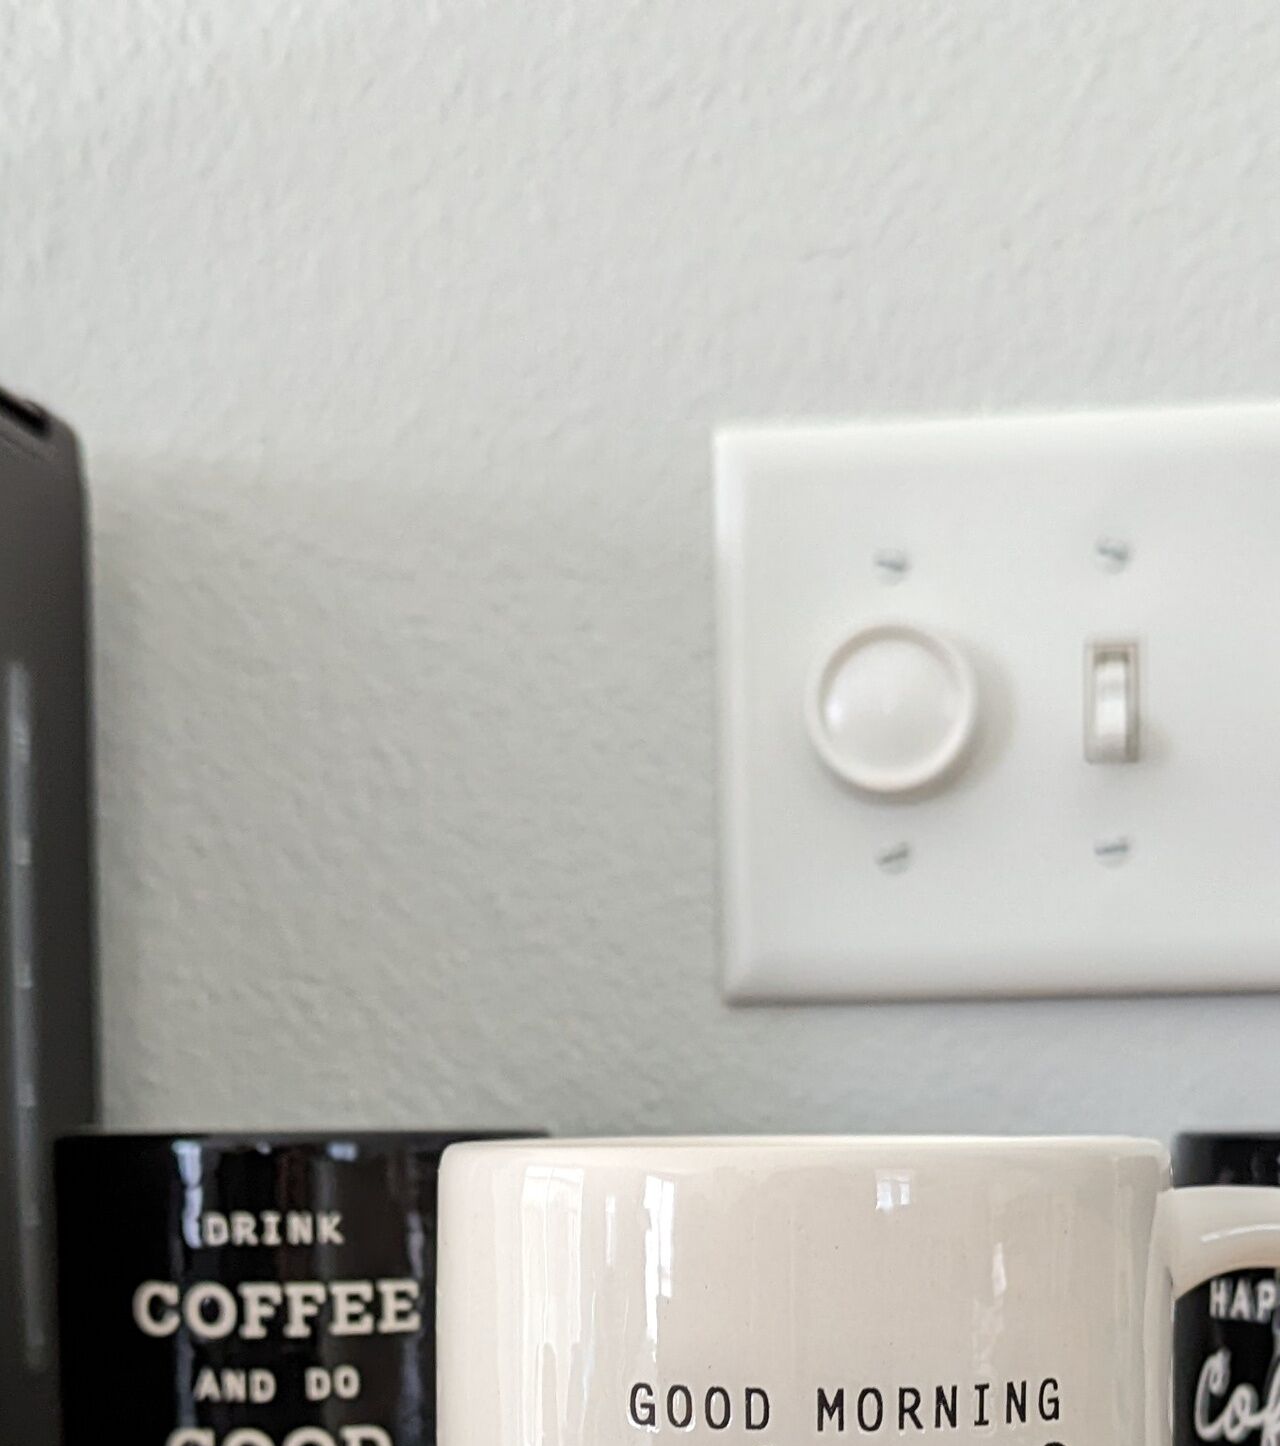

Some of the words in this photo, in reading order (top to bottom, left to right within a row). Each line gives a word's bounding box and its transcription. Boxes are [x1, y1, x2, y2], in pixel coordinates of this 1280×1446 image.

[202, 1210, 347, 1246] DRINK
[131, 1279, 421, 1340] COFFEE
[193, 1367, 278, 1403] AND
[304, 1366, 361, 1401] DO
[628, 1382, 771, 1431] GOOD
[817, 1376, 1062, 1432] MORNING
